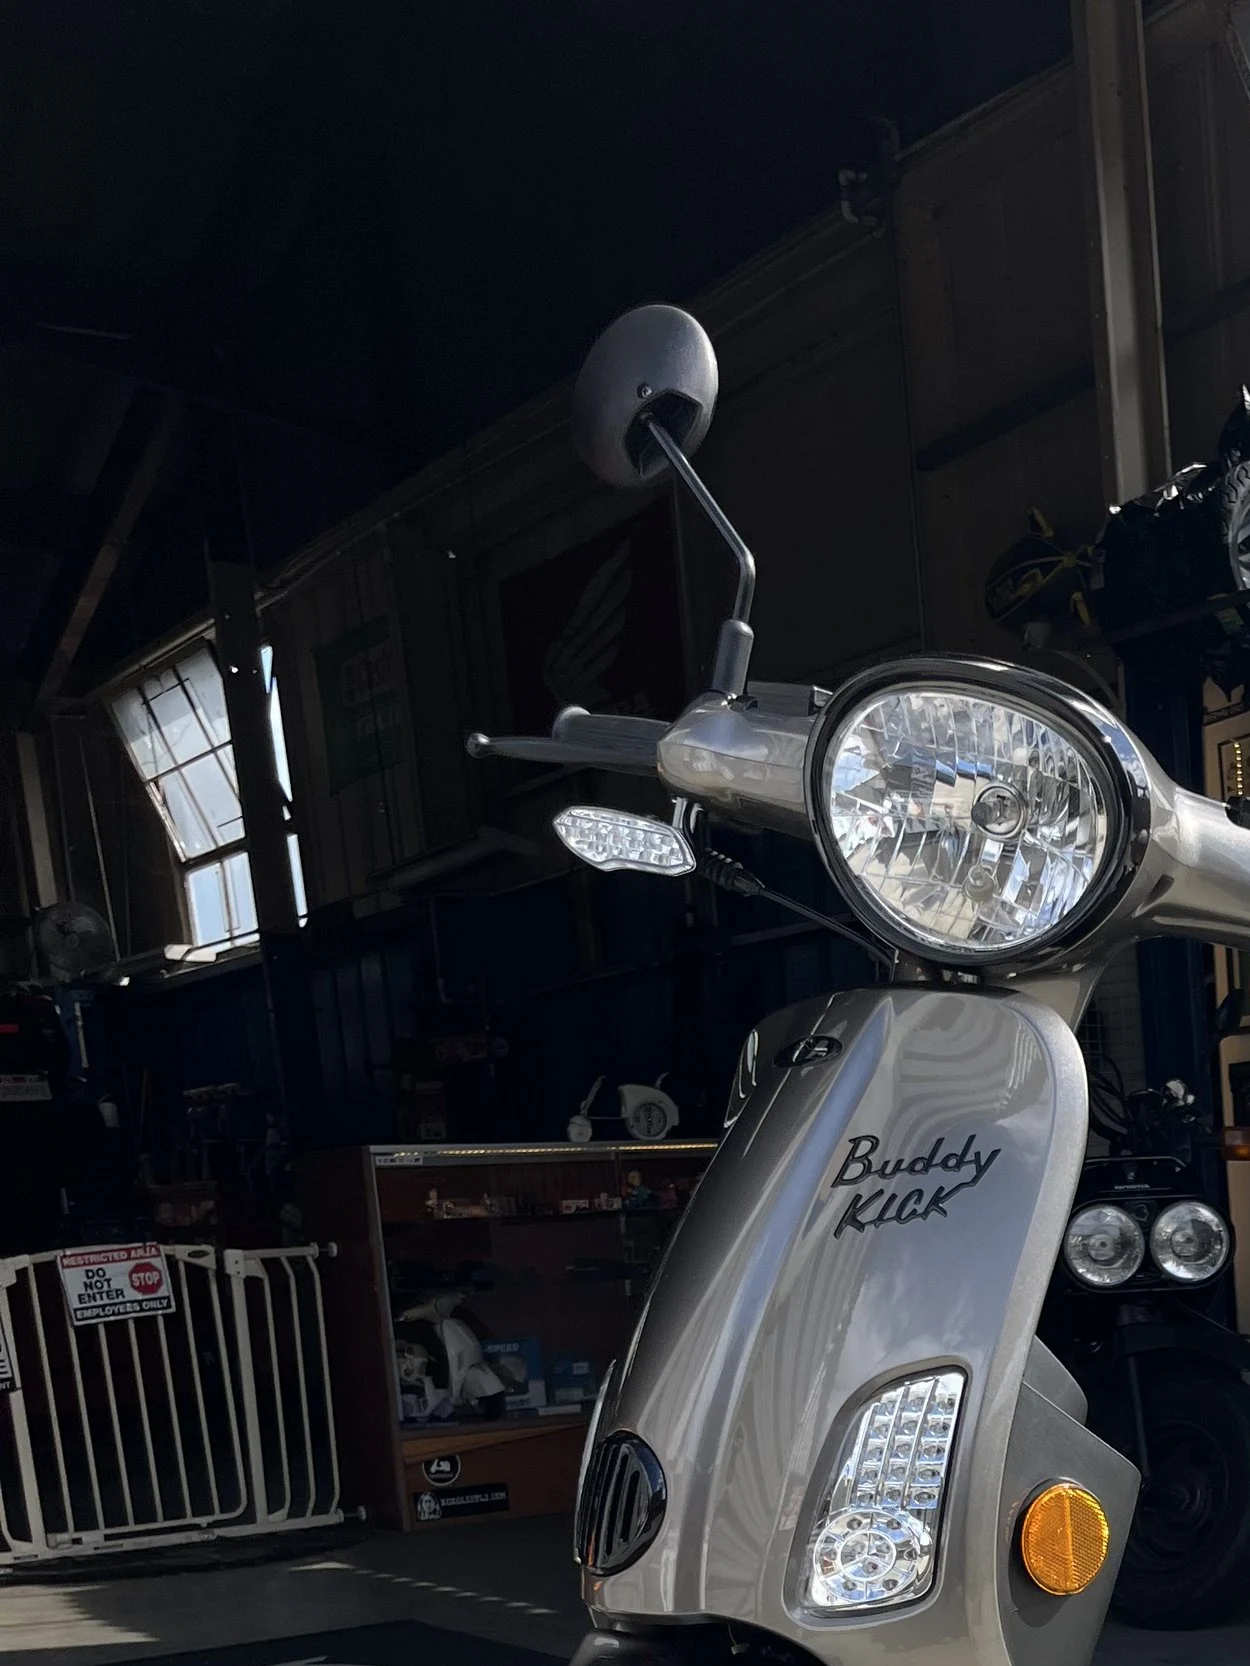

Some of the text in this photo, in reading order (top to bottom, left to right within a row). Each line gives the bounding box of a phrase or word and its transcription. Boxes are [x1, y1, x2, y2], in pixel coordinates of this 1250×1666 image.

[831, 1134, 1001, 1188] Buddy
[833, 1185, 958, 1239] KICK
[62, 1251, 127, 1267] RESTRICTED
[85, 1267, 106, 1280] DO
[131, 1271, 160, 1287] STOP
[83, 1278, 112, 1292] NOT
[77, 1288, 126, 1304] ENTER
[76, 1299, 168, 1319] EMPLOYEES ONLY
